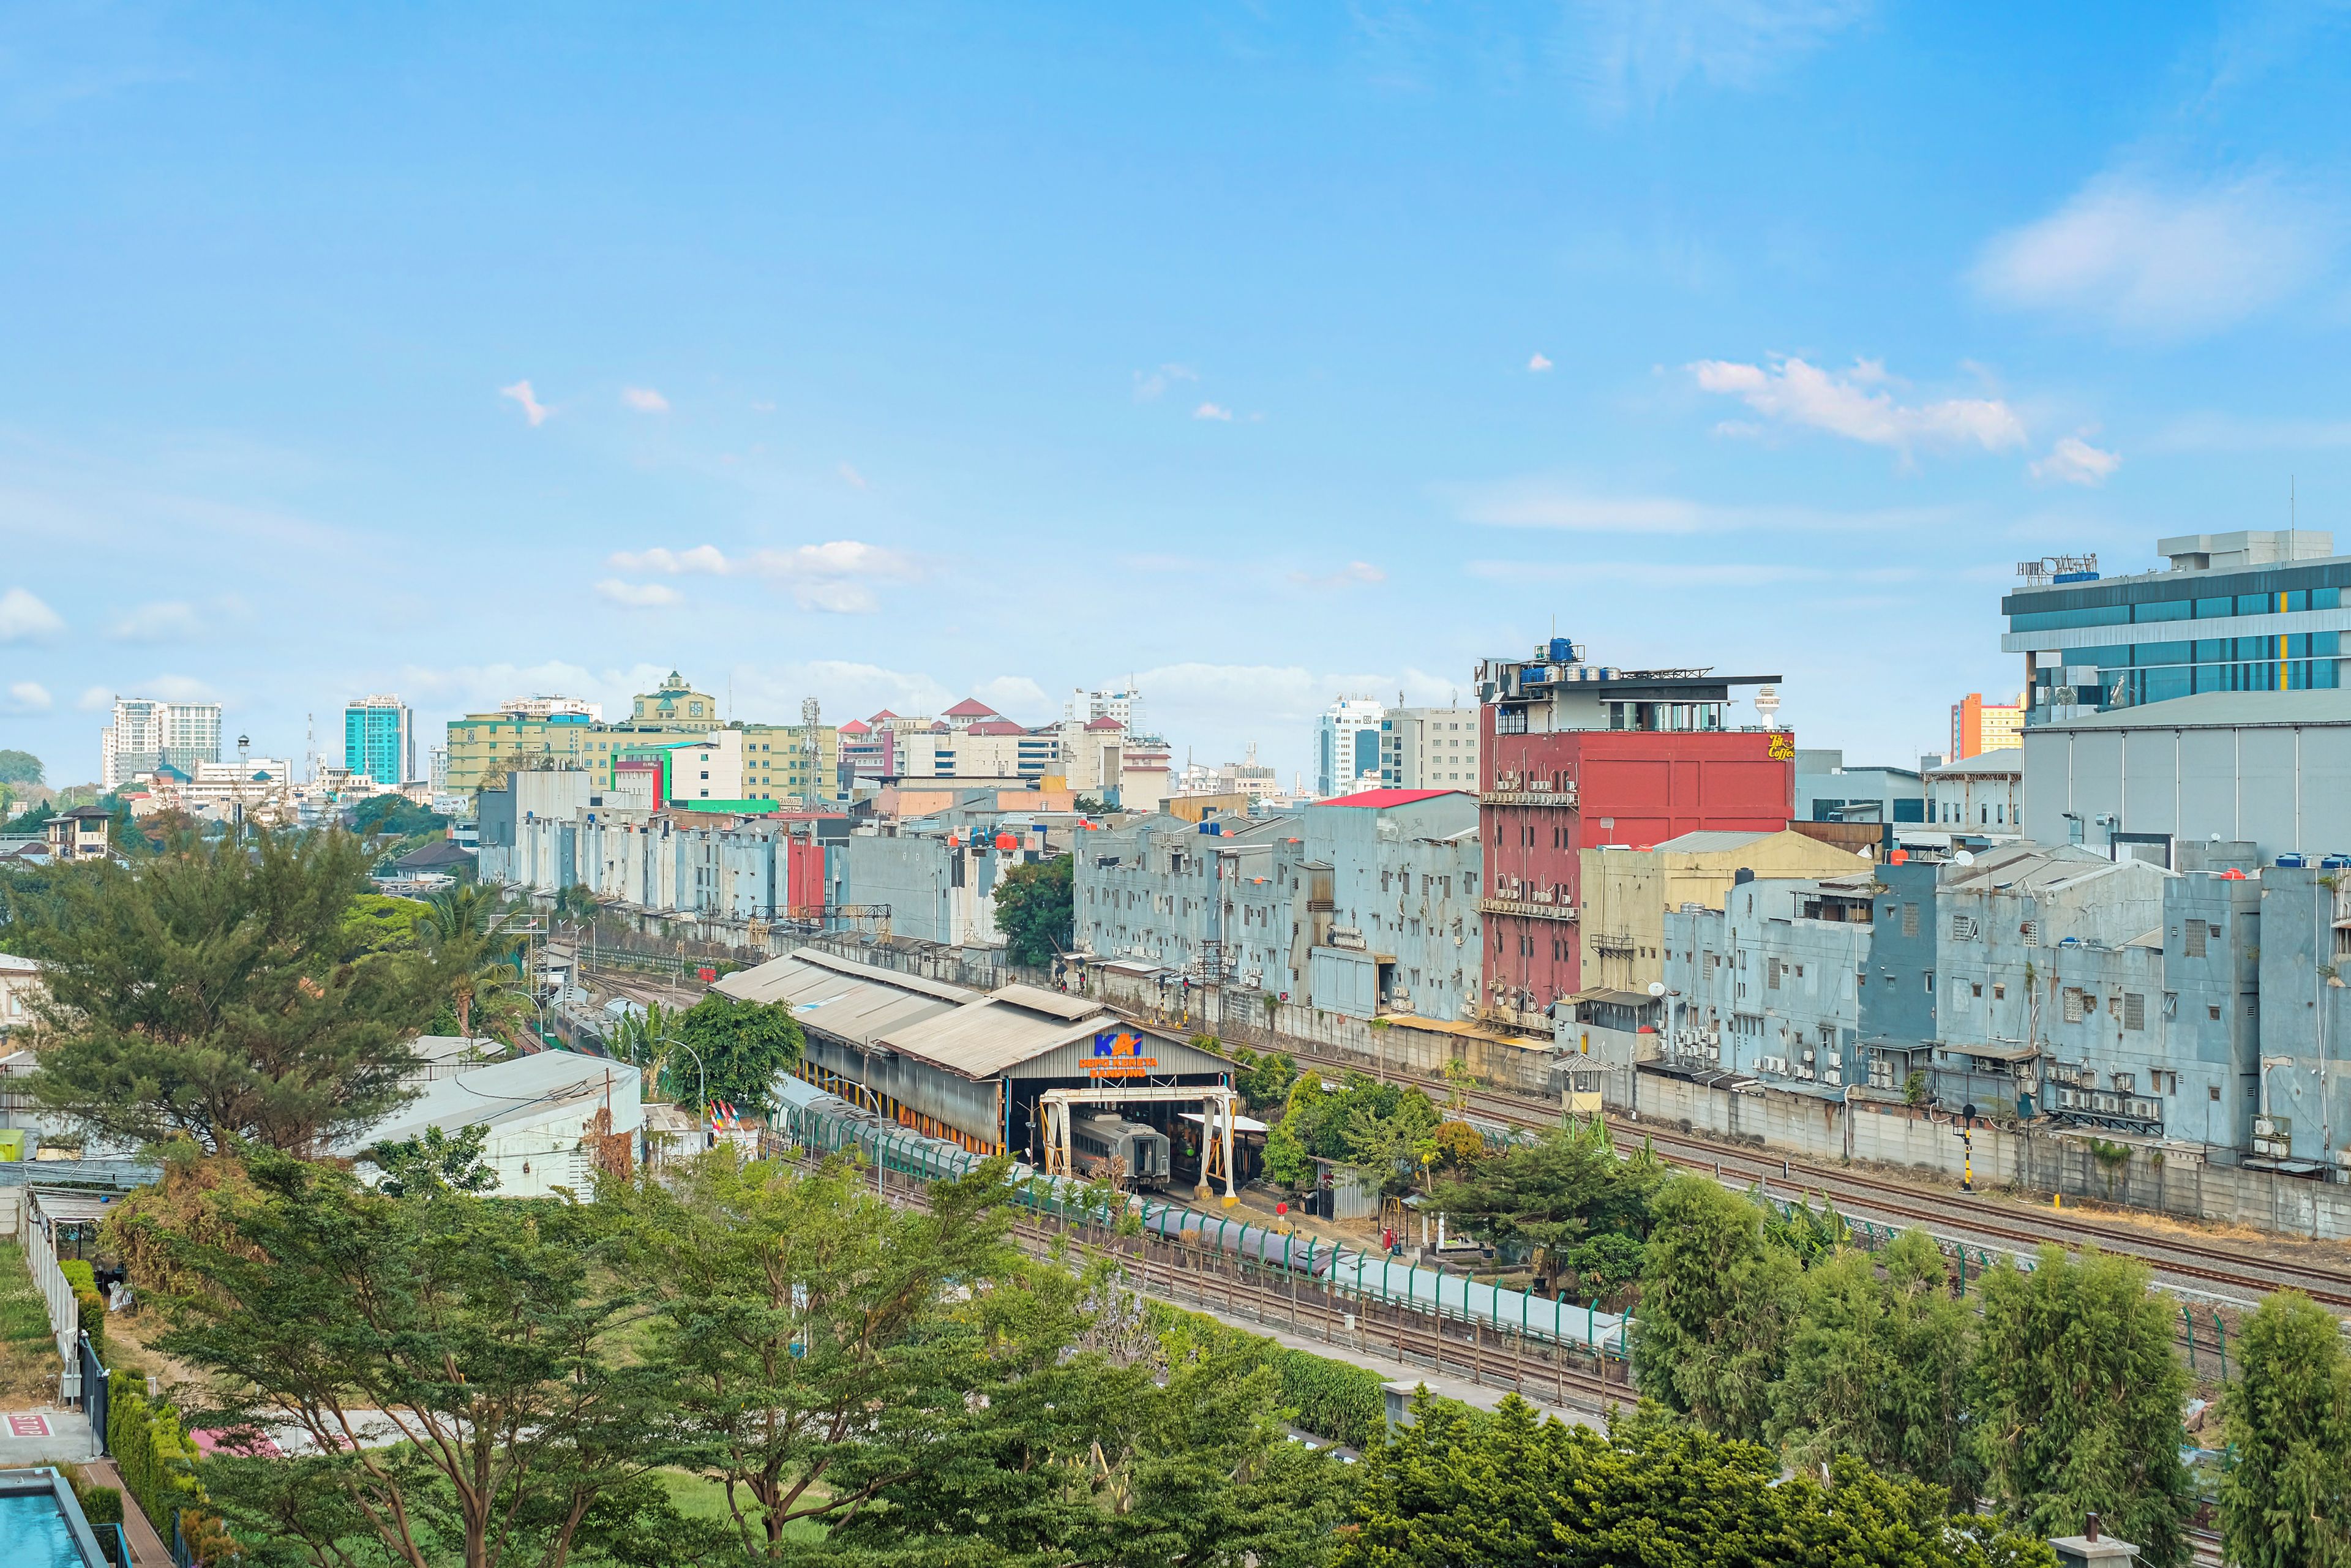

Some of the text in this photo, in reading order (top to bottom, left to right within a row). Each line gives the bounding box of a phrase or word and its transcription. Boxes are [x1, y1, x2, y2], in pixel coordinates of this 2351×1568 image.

[1094, 1033, 1142, 1056] KAI
[1079, 1057, 1158, 1068] DEPO KERETA
[1090, 1068, 1146, 1078] BANDUNG
[15, 1416, 42, 1435] STOP
